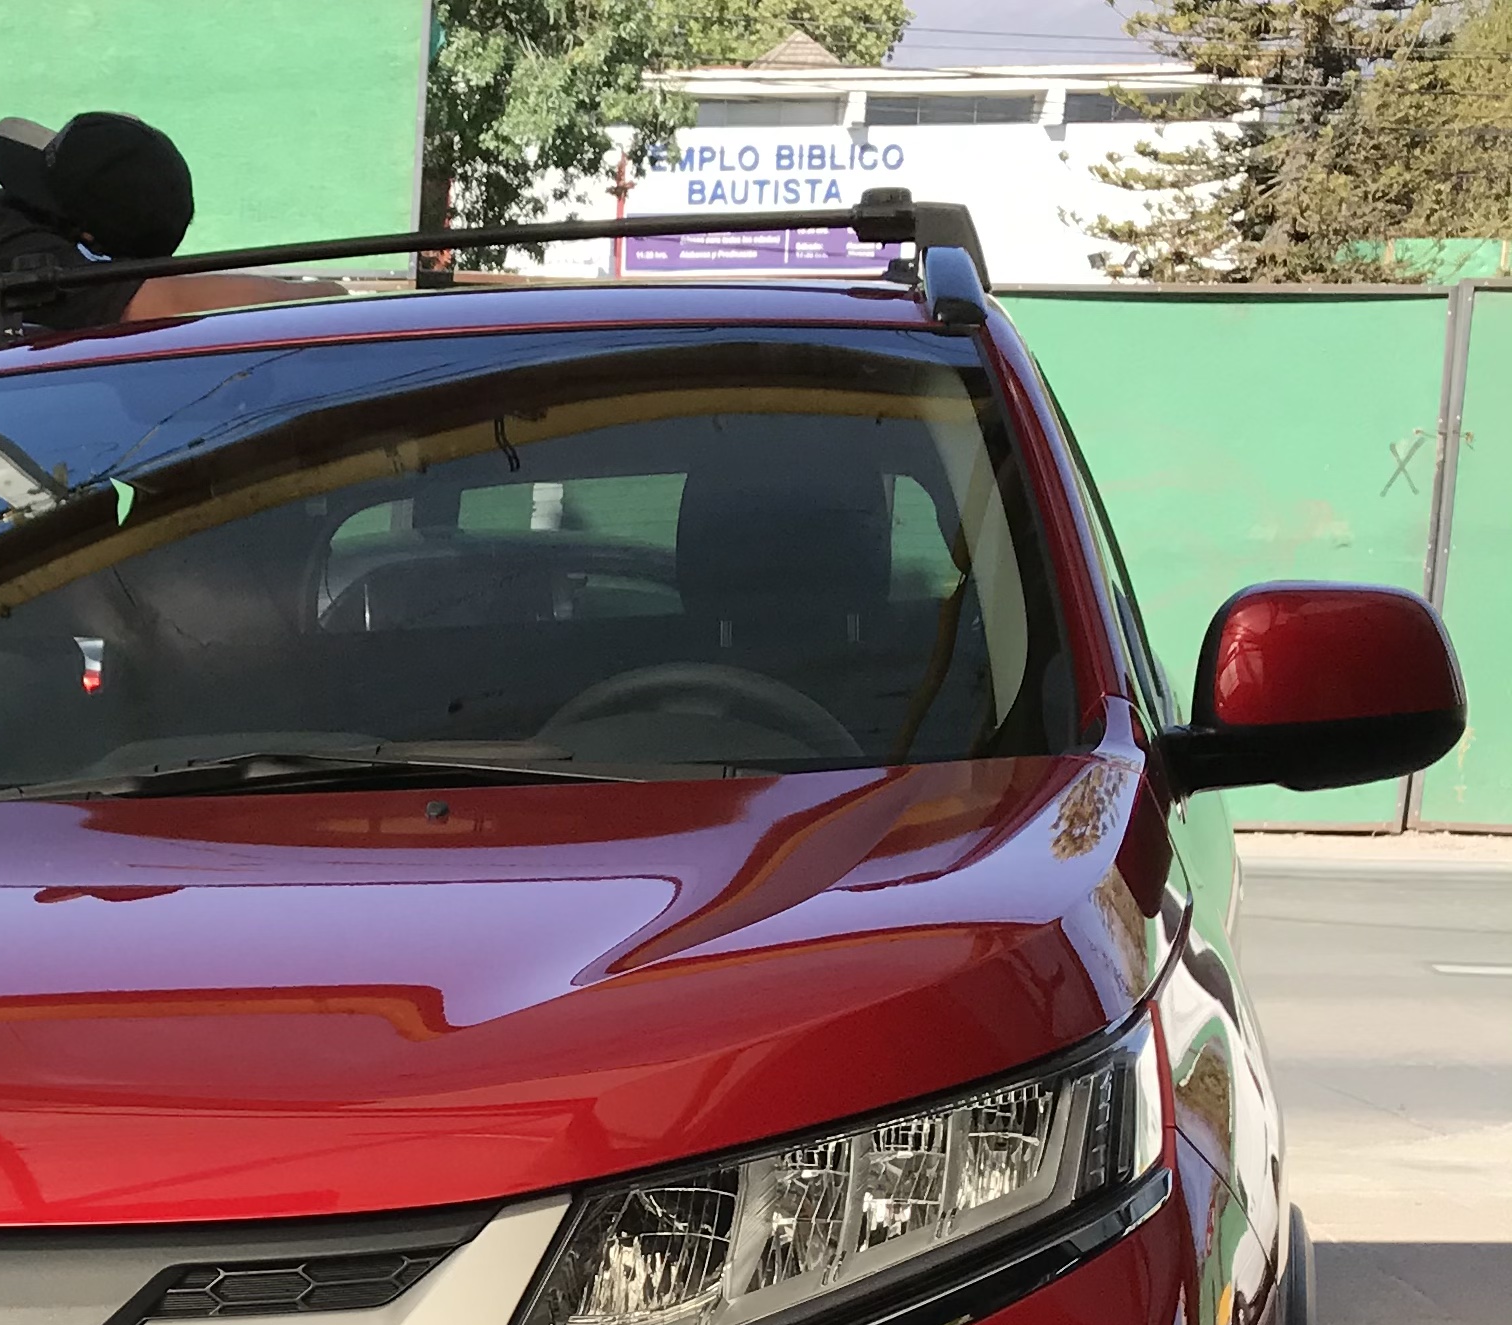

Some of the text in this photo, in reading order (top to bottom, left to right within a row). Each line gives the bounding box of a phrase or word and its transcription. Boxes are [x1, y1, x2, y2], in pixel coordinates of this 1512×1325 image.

[646, 143, 905, 172] EMPLO BIBLICO
[687, 178, 843, 205] BAUTISTA
